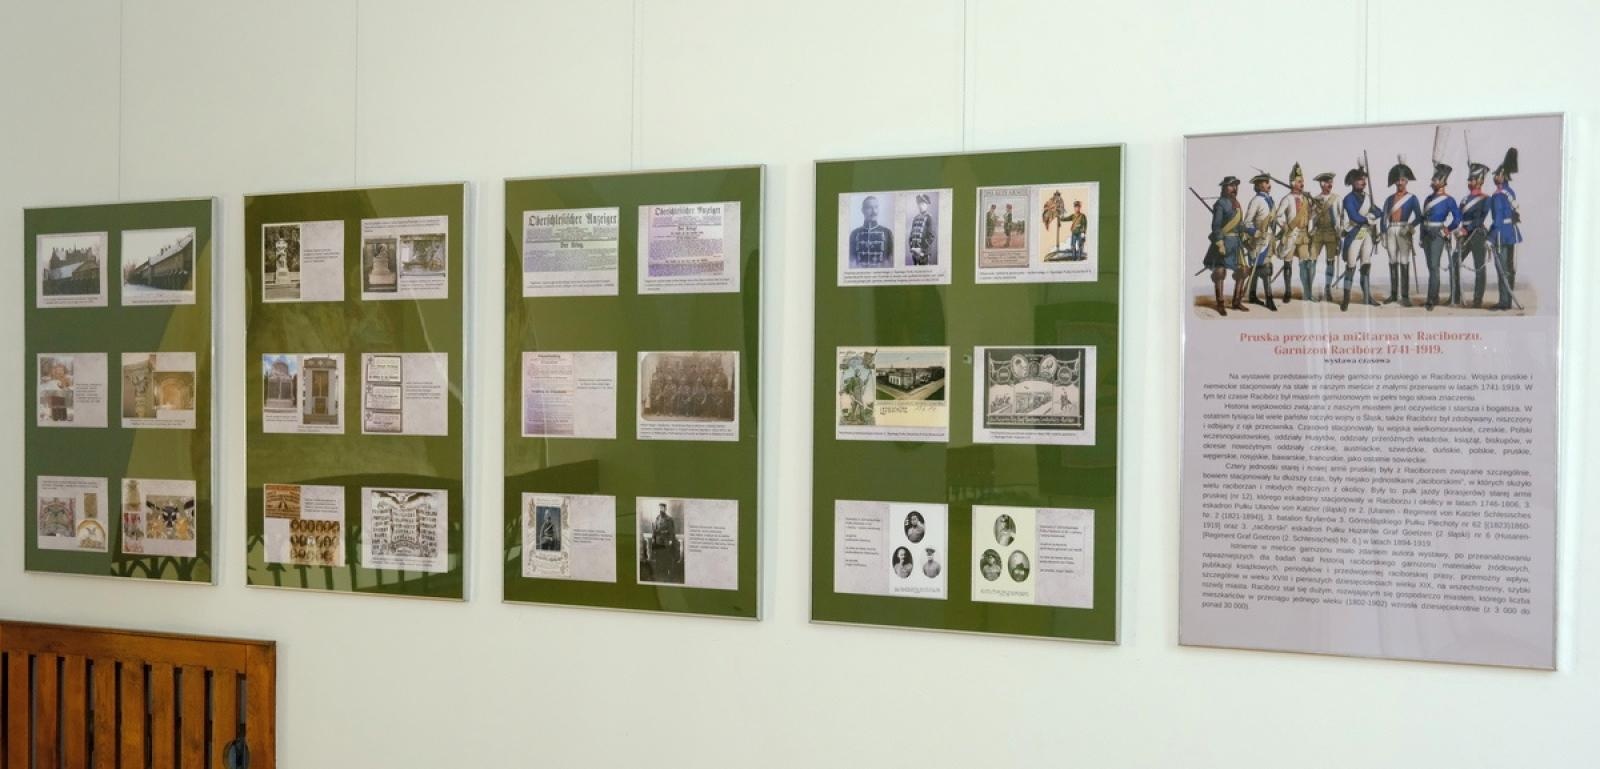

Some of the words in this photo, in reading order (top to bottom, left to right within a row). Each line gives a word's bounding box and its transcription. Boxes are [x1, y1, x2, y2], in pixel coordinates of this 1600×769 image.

[1240, 332, 1280, 343] Pruska
[1283, 332, 1340, 345] prezencja
[1343, 331, 1400, 342] militarna
[1403, 333, 1413, 341] w
[1416, 331, 1483, 342] Raciborzu.
[1273, 345, 1328, 356] Garnizon
[1331, 343, 1383, 356] Racibórz
[1323, 357, 1357, 366] wystawa
[1358, 357, 1391, 365] czasowa
